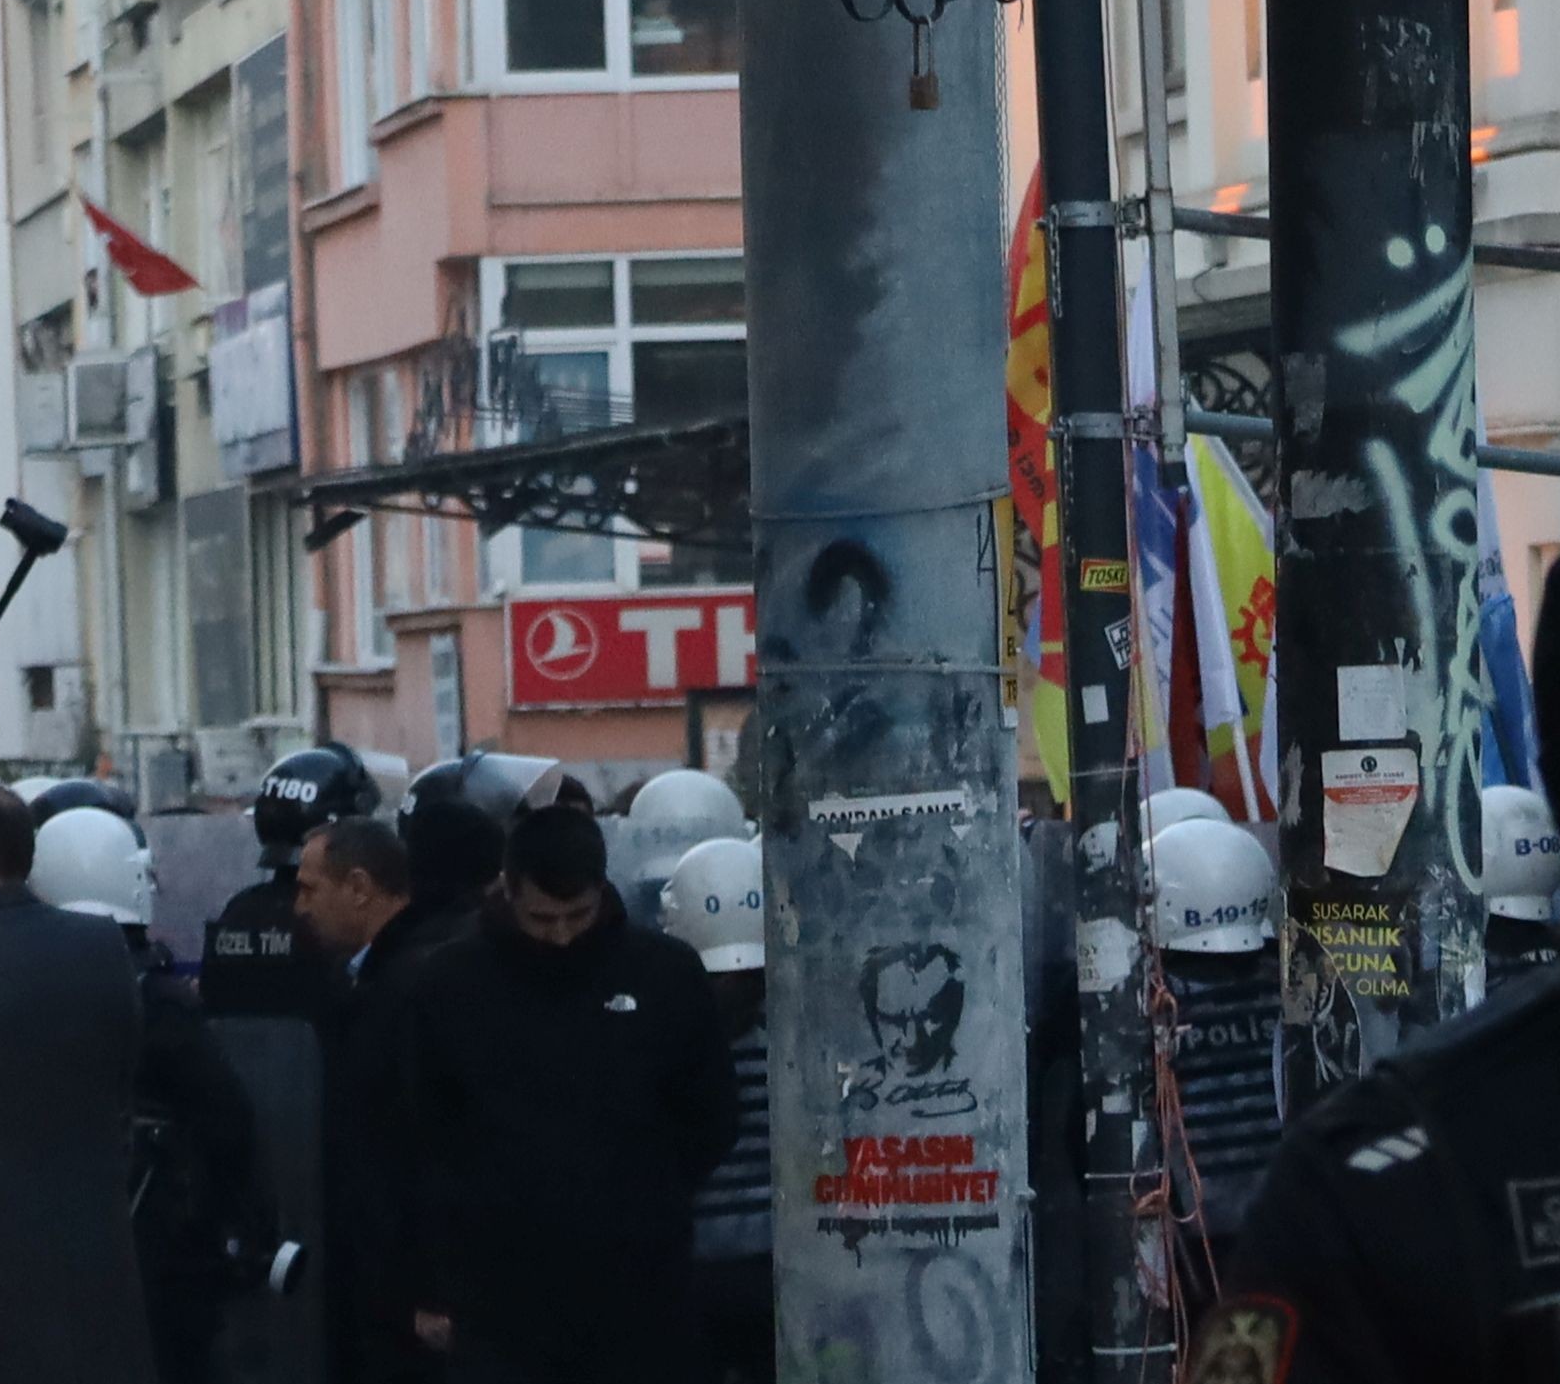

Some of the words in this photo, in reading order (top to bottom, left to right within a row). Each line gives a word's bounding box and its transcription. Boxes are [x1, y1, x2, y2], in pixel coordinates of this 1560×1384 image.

[1311, 902, 1391, 921] SUSARAK
[1308, 925, 1401, 948] NSANLIK
[1355, 977, 1410, 997] OLMA
